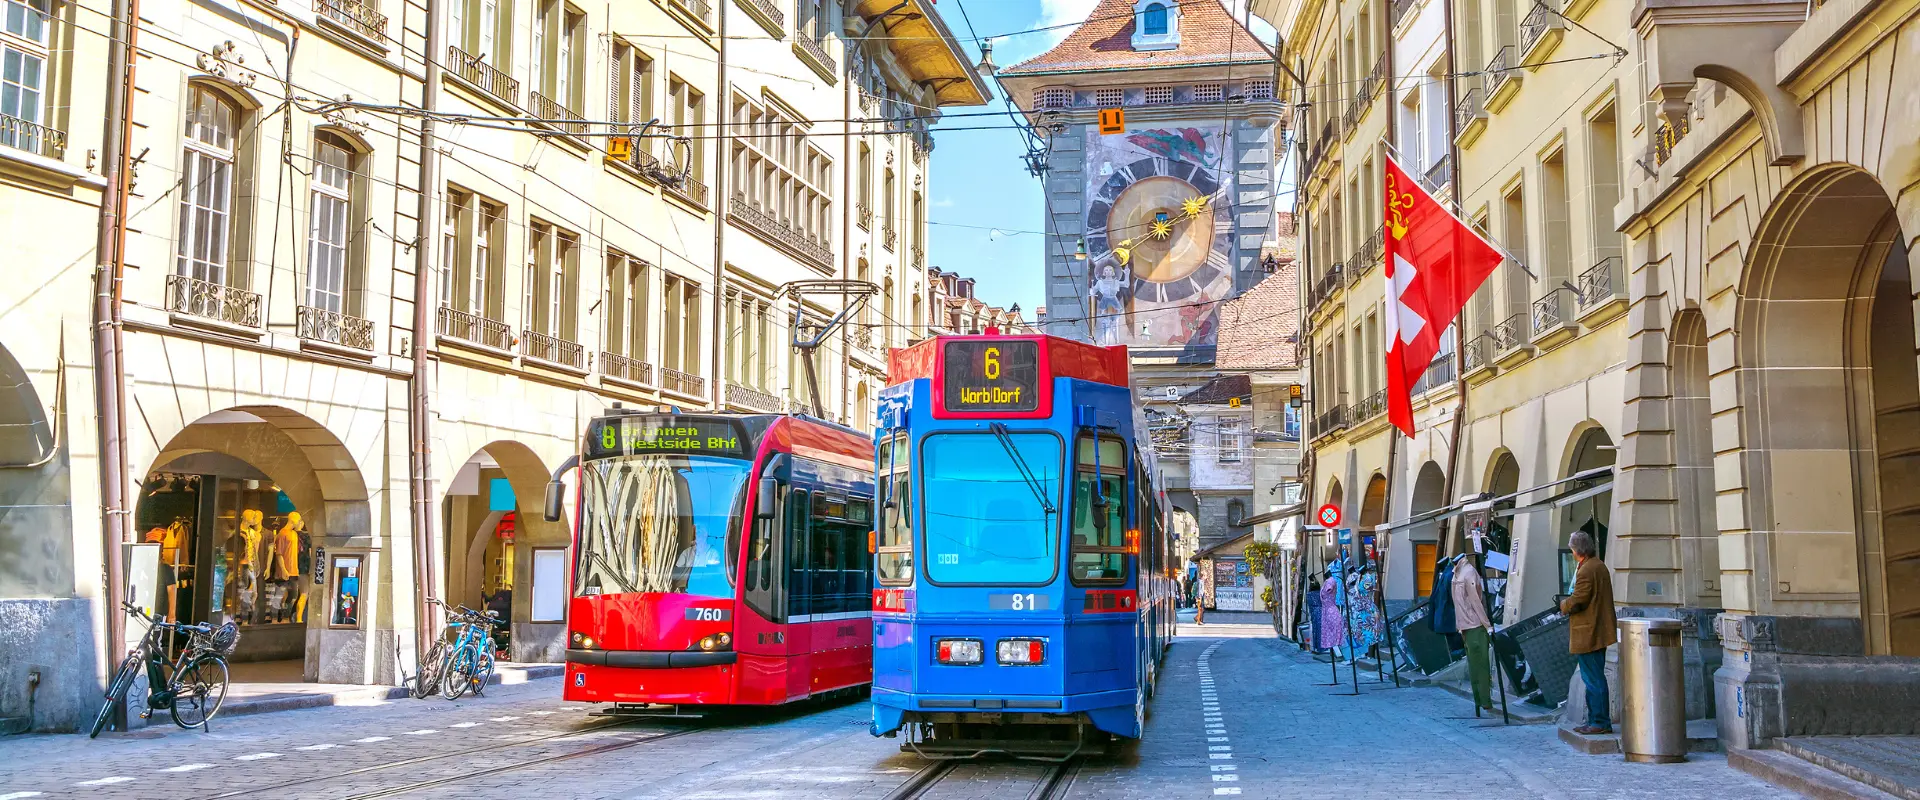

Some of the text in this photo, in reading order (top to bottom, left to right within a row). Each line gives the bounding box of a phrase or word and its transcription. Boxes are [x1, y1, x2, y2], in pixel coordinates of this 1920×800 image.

[984, 347, 1000, 380] 6
[961, 386, 1021, 404] Worb Dorf
[1168, 388, 1176, 396] 12
[602, 425, 616, 449] 8
[621, 426, 698, 436] Brünnen
[622, 437, 737, 449] Westside Bhf
[1011, 593, 1035, 611] 81
[695, 608, 722, 621] 760
